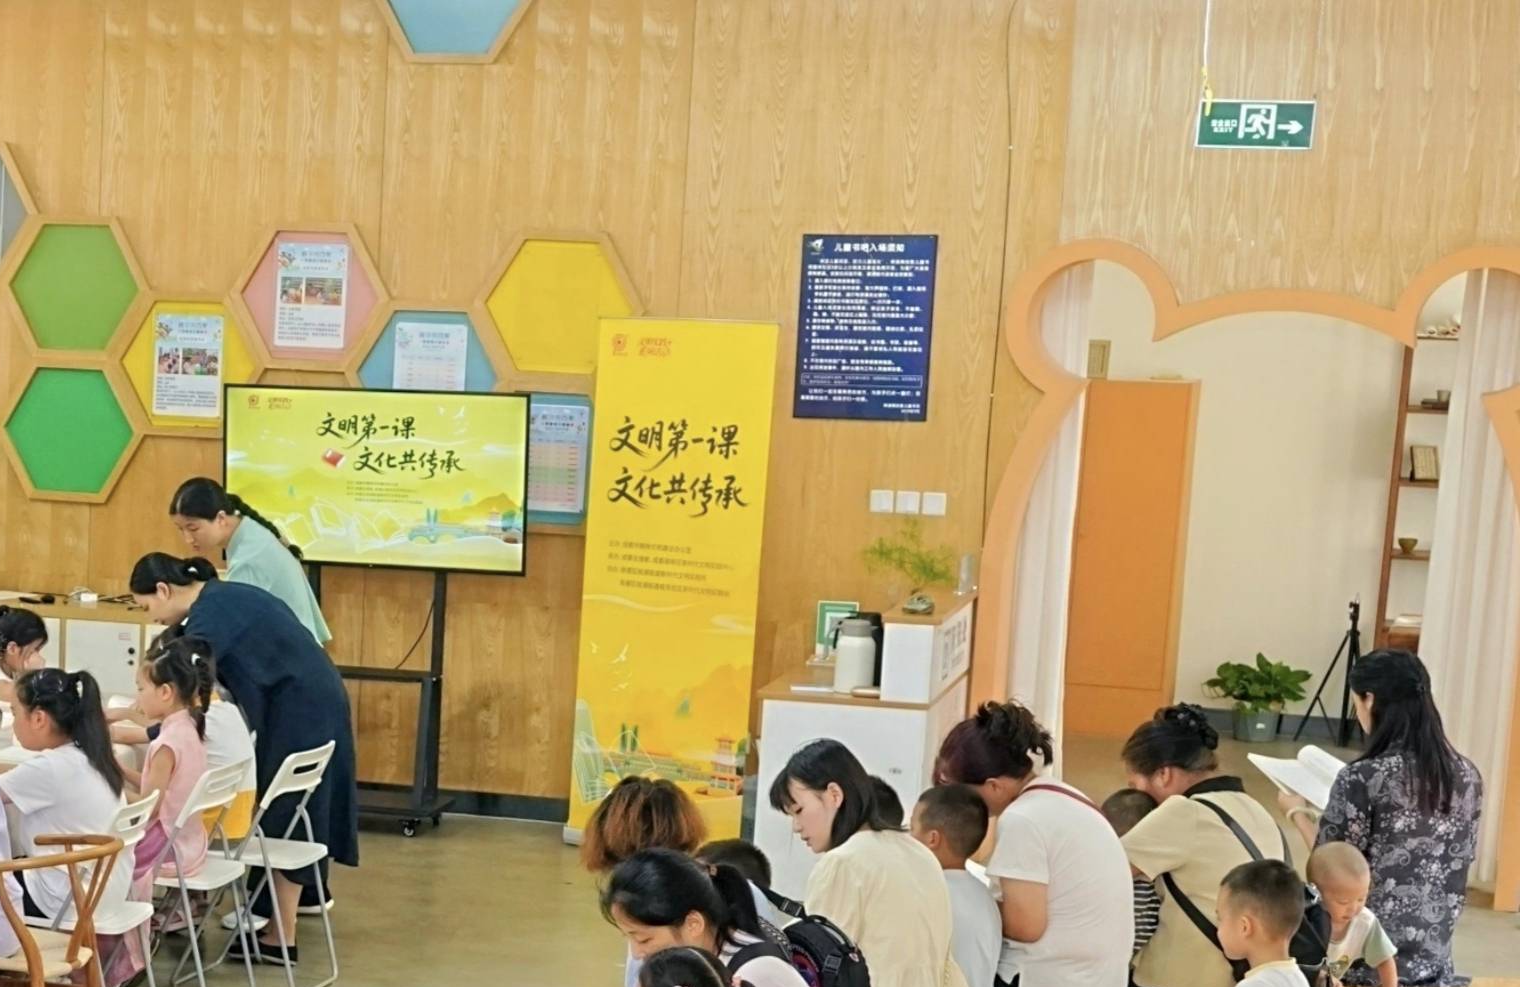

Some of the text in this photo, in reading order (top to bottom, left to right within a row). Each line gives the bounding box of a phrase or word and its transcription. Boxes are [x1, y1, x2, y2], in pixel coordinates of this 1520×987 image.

[316, 412, 416, 449] 文明第一课
[609, 416, 739, 472] 文明第一课
[354, 446, 466, 480] 文化共传承
[607, 467, 749, 518] 文化共传承
